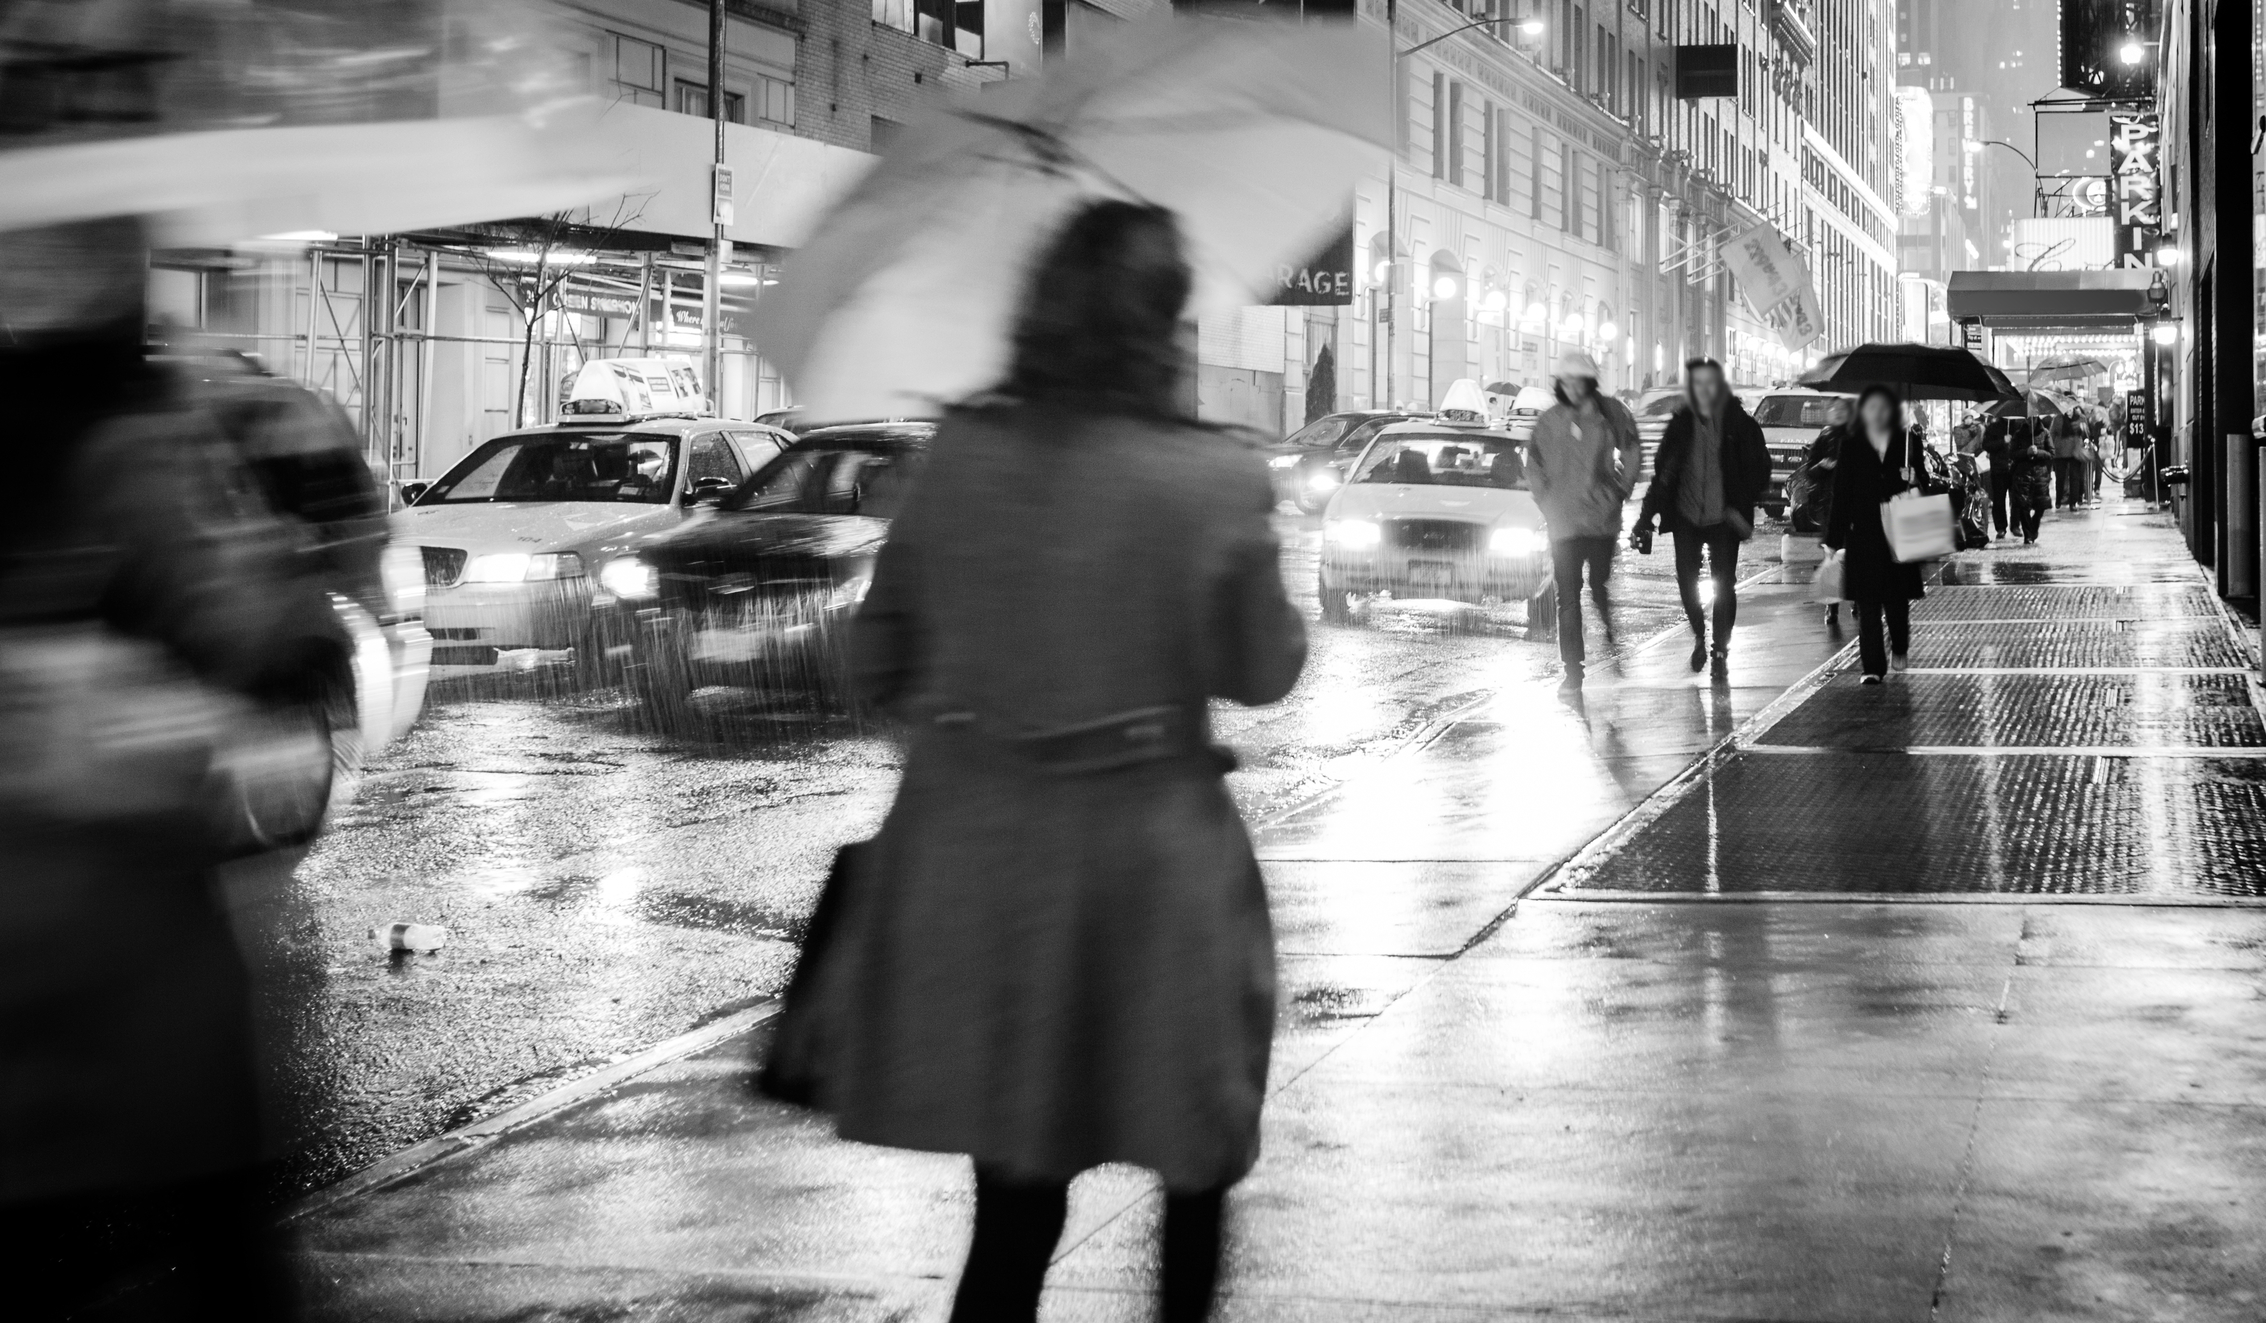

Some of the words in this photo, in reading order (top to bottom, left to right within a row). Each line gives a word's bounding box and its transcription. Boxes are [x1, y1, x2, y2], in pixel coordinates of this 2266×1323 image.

[1962, 97, 1974, 195] BREWERY
[2117, 123, 2154, 269] PARKIN
[1277, 264, 1350, 296] RAGE
[676, 310, 700, 325] Where
[2129, 423, 2144, 435] $13
